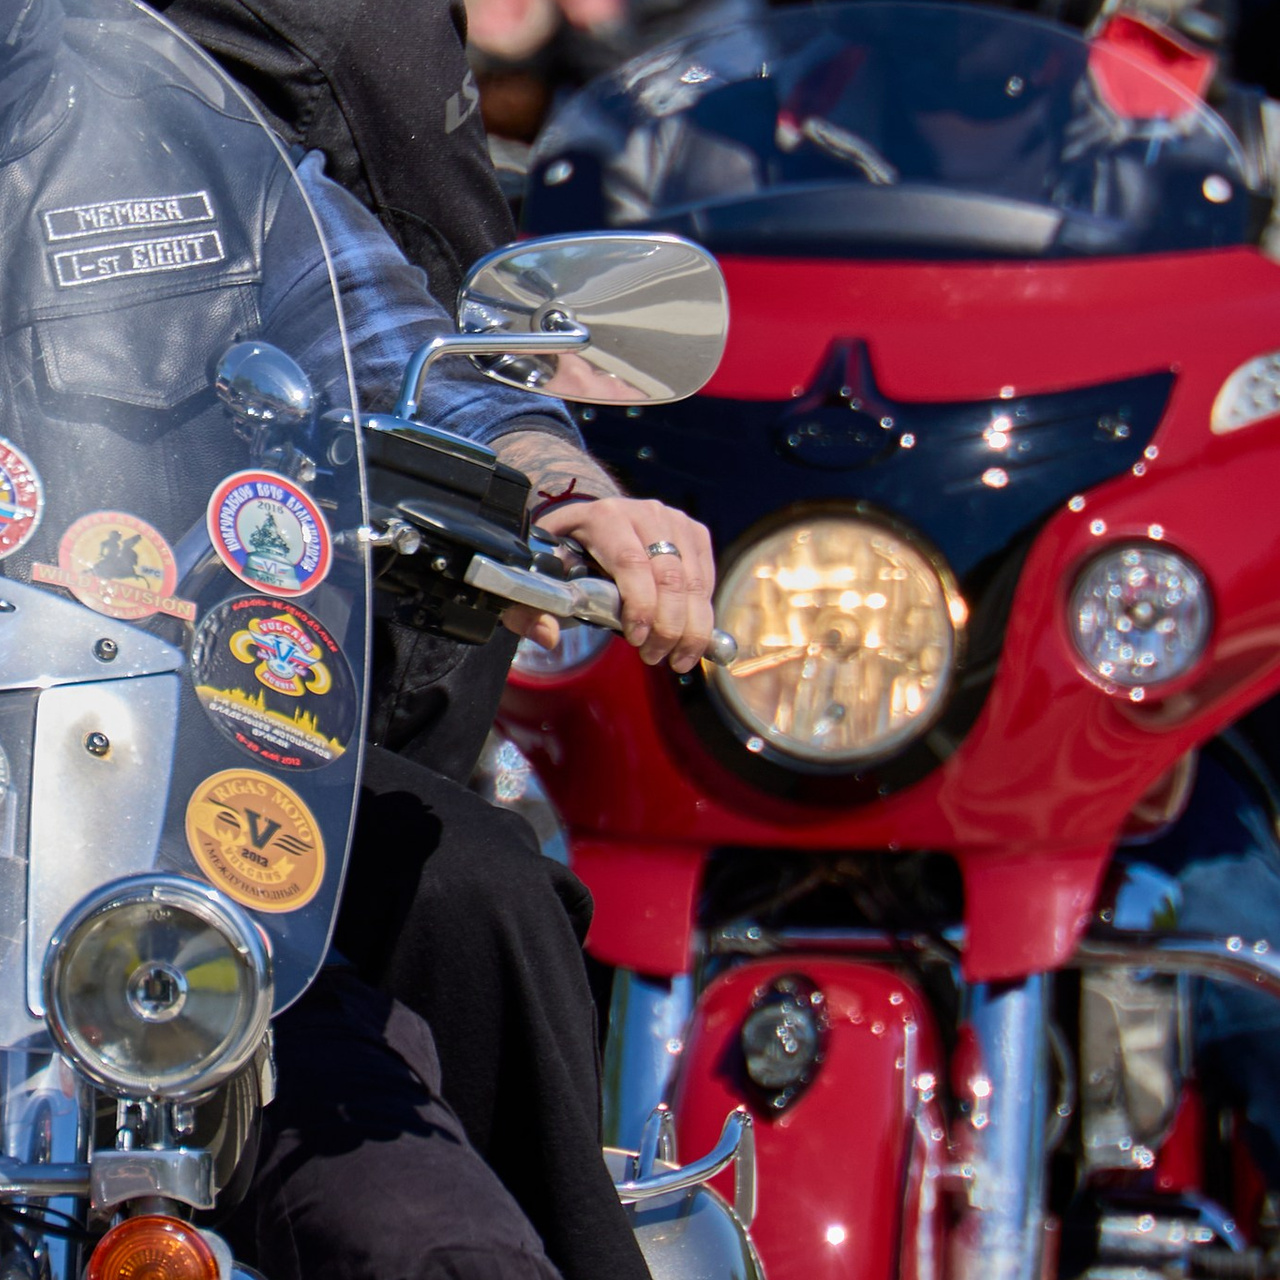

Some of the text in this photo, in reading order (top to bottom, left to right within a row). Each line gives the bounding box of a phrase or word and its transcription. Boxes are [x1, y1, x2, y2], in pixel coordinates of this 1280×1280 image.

[75, 199, 184, 230] MEMBER
[130, 238, 205, 270] EIGHT
[38, 566, 93, 588] WILD
[98, 580, 192, 617] DIVISION
[259, 621, 313, 652] VULCANS
[214, 779, 313, 842] RIGAS MOTO
[207, 847, 301, 900] МЕЖДУНАРОДНЫЙ
[225, 846, 282, 882] VULCANS
